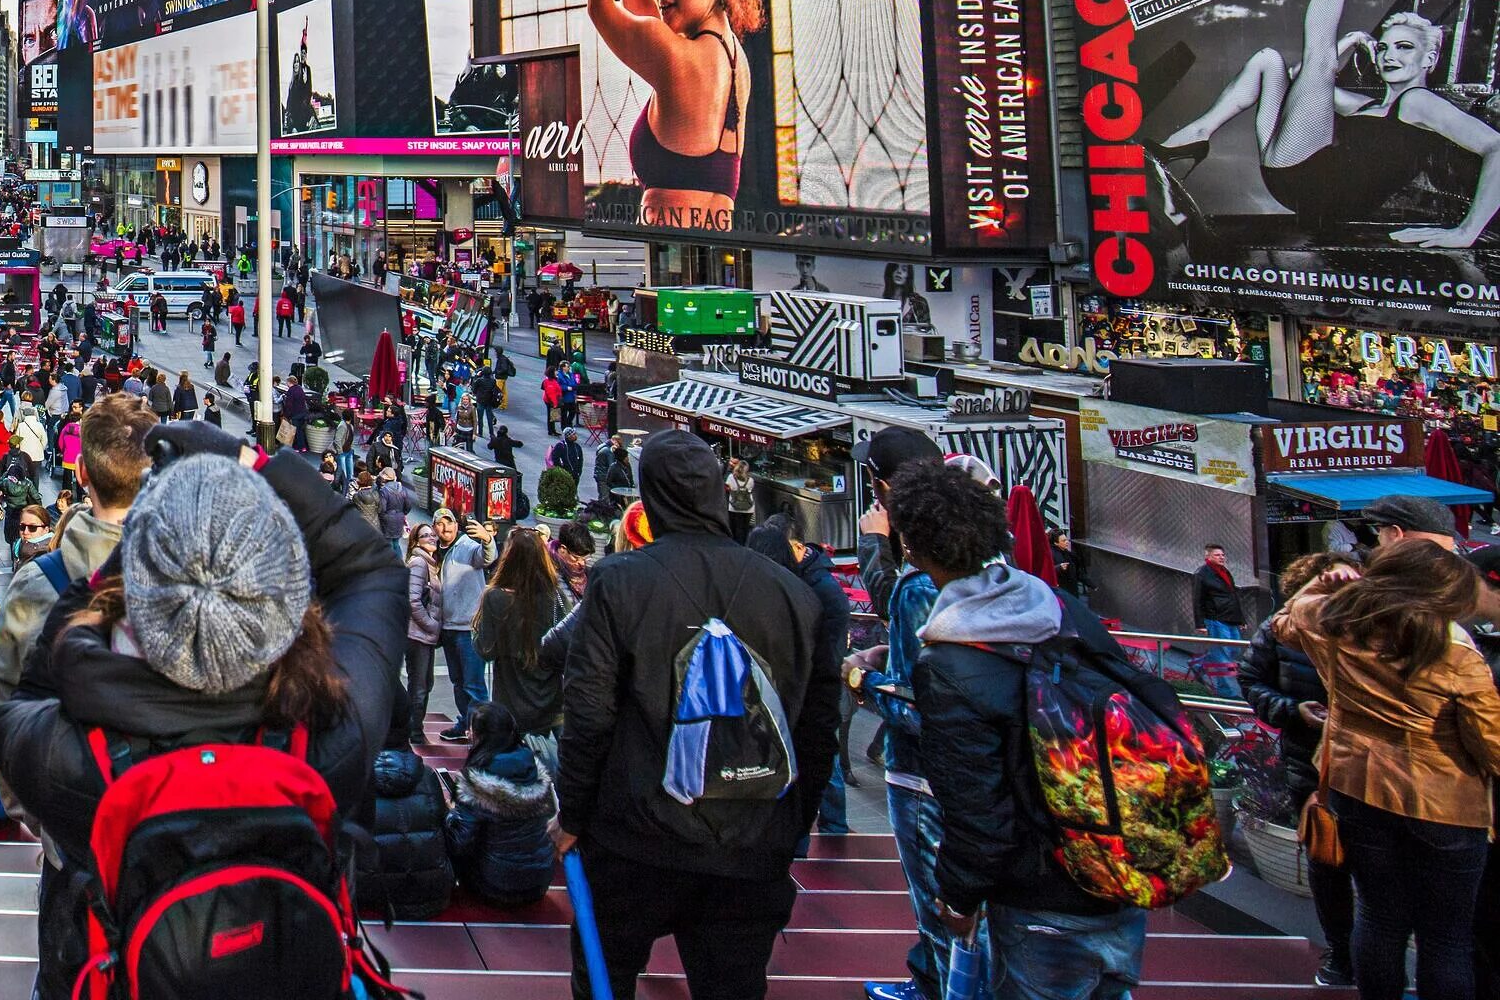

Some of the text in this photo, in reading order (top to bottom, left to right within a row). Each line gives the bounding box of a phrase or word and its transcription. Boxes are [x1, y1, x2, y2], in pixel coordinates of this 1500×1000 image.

[997, 35, 1029, 162] AMERICAN
[954, 73, 989, 158] aerie
[408, 141, 510, 150] STEP INSIDE. SNAP YOUR
[548, 162, 579, 173] AERIE.COM
[1002, 168, 1029, 200] OF
[969, 162, 1000, 231] VISIT
[586, 202, 684, 226] AMERICAN
[690, 207, 757, 232] EAGLE
[1184, 263, 1500, 301] CHICAGOTHEMUSICAL.COM
[1167, 282, 1231, 293] TELECHARGE.COM
[1244, 289, 1292, 300] AMBASSADOR
[1294, 293, 1323, 302] THEATRE
[1349, 298, 1375, 307] STREET
[1386, 301, 1431, 311] BROADWAY
[1448, 306, 1484, 316] American
[625, 328, 675, 355] DRINK
[742, 361, 761, 374] NYC's
[742, 370, 761, 382] best
[761, 365, 831, 395] HOT DOGS
[674, 414, 689, 424] BEER
[1108, 424, 1198, 448] VIRGIL'S
[1273, 424, 1404, 458] VIRGIL'S
[1117, 450, 1194, 470] BARBECUE
[1153, 450, 1193, 463] REAL
[1289, 455, 1392, 468] REAL BARBECUE
[432, 463, 457, 485] JERSEY
[489, 479, 509, 494] JERSEY
[491, 489, 506, 502] BOYS
